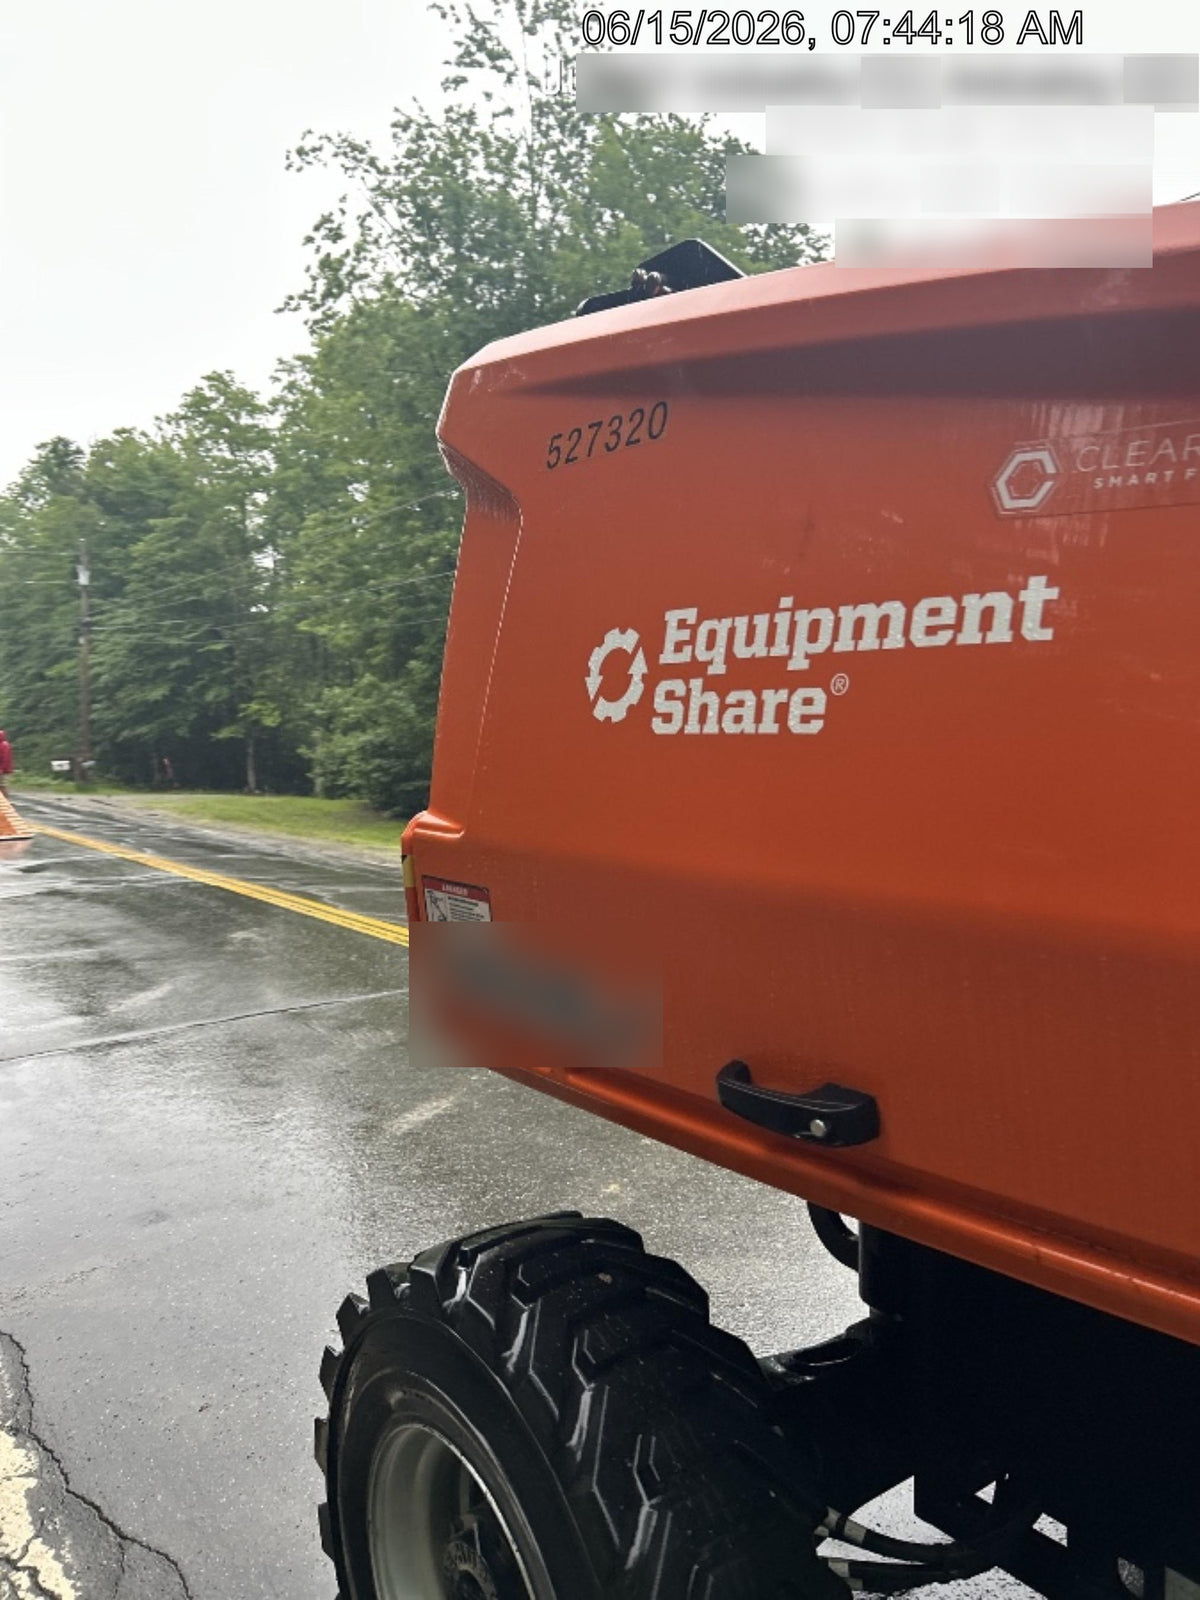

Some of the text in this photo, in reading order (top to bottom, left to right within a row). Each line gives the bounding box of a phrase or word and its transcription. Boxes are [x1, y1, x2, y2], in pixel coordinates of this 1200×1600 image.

[546, 400, 668, 469] 527320
[1094, 470, 1174, 489] SMART
[659, 575, 1059, 674] Equipment
[651, 678, 828, 735] Share
